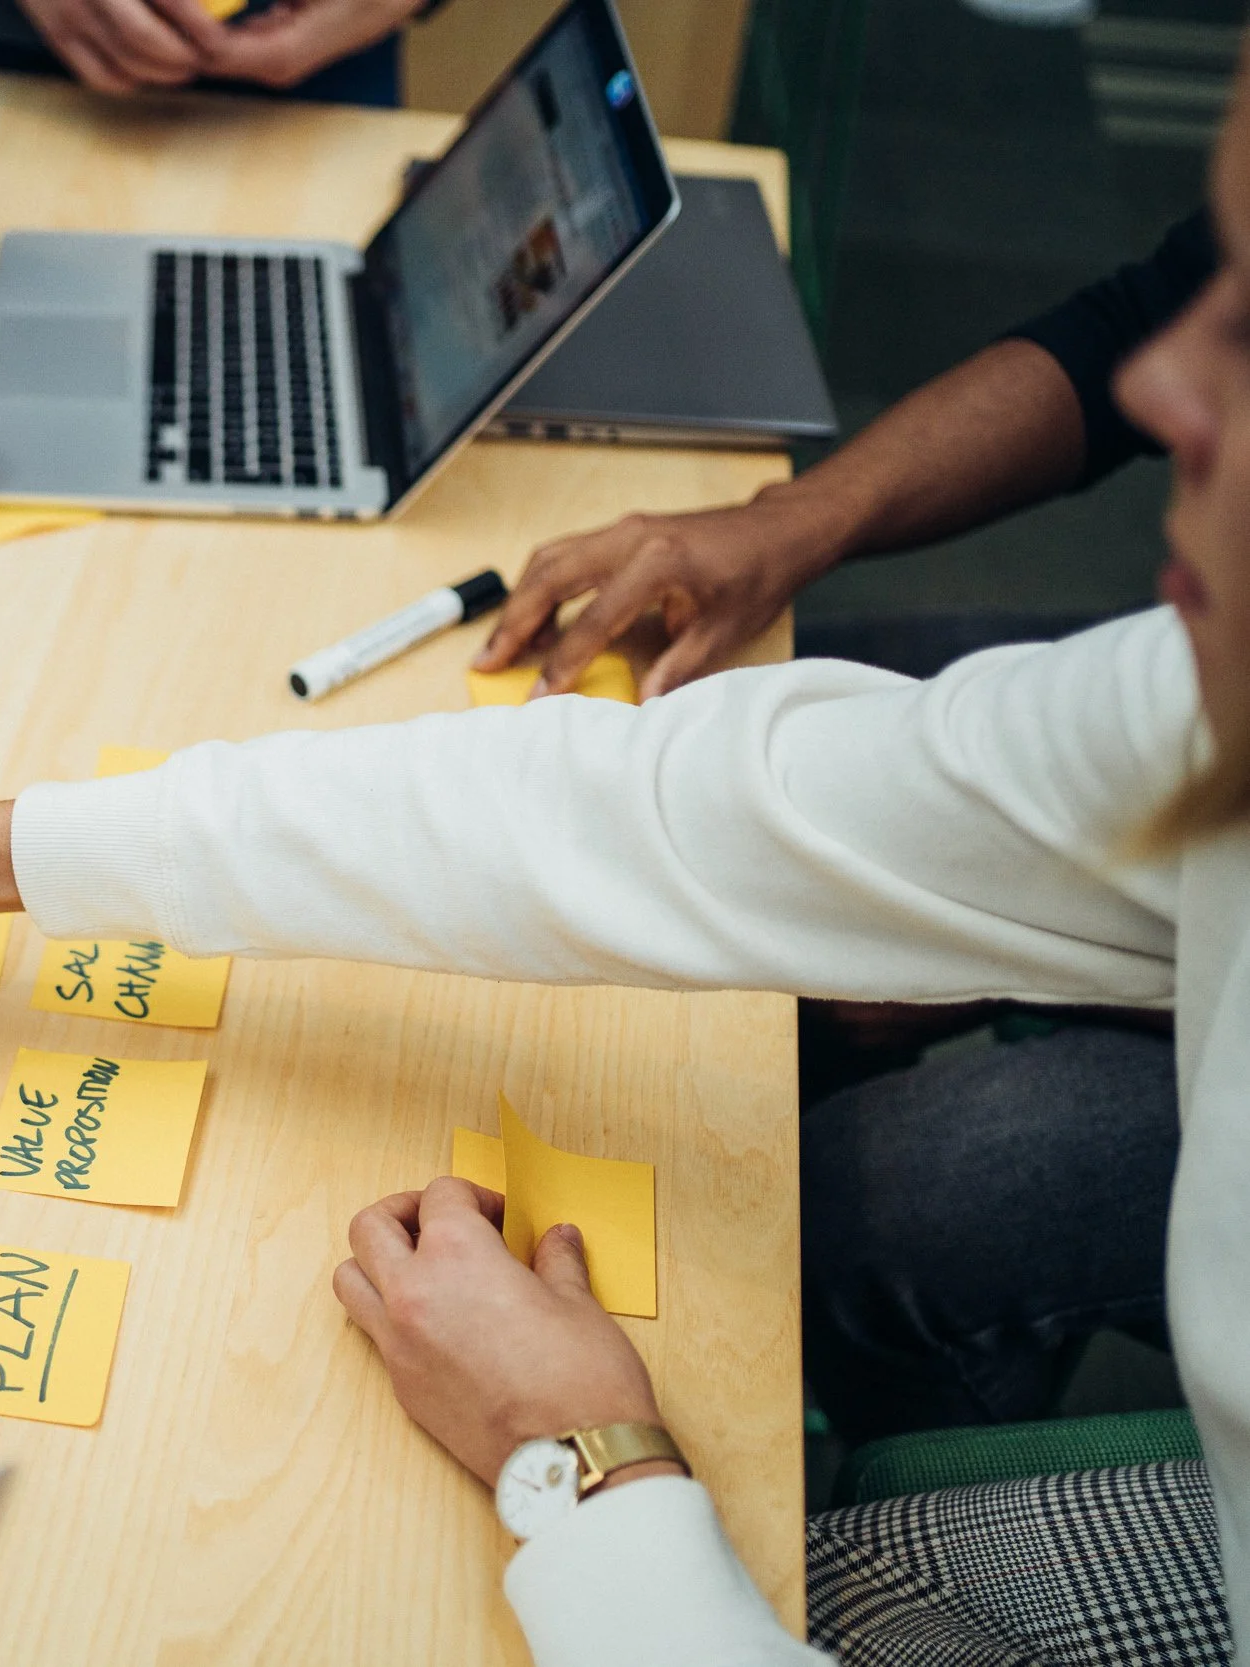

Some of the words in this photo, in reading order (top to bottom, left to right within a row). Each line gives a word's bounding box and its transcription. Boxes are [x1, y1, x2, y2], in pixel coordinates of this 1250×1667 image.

[55, 943, 100, 1003] SAL
[0, 1082, 59, 1177] VALUE
[54, 1057, 121, 1190] PROPOSITION
